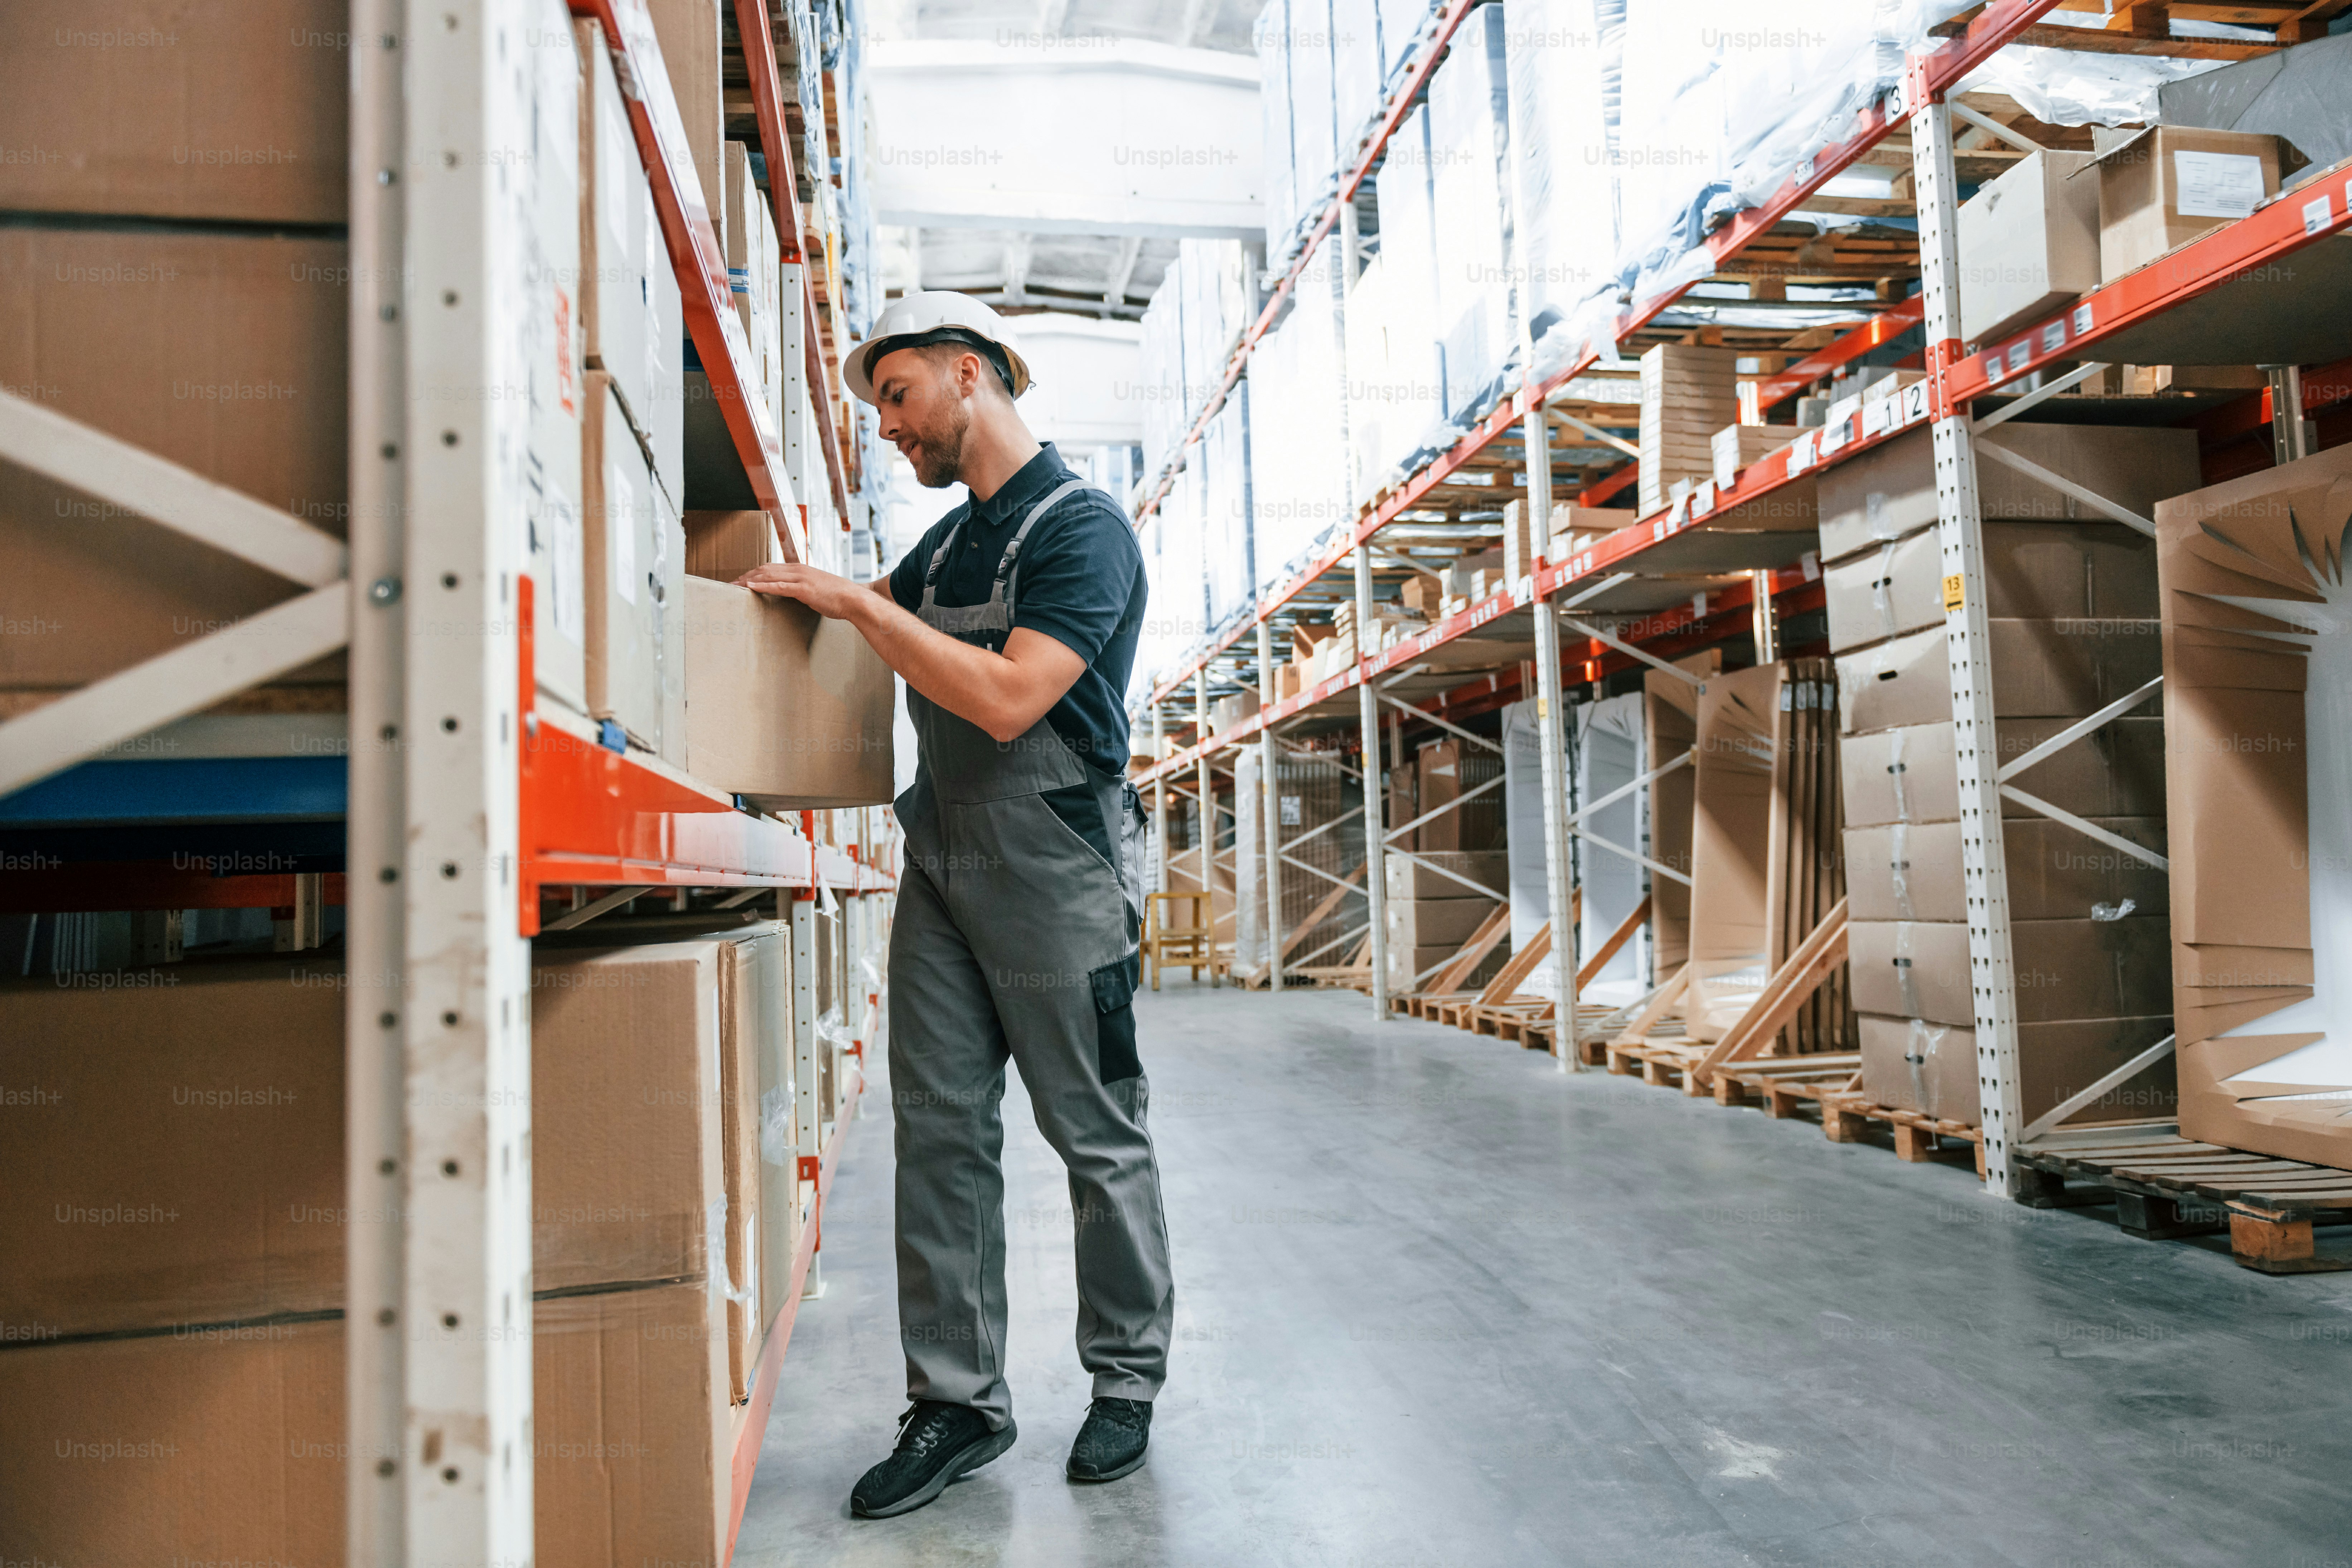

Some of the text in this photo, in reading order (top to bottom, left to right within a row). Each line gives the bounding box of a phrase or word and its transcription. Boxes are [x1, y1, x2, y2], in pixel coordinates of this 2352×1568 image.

[1891, 85, 1901, 116] 3
[1886, 386, 1922, 426] 1 2
[1947, 577, 1960, 591] 13
